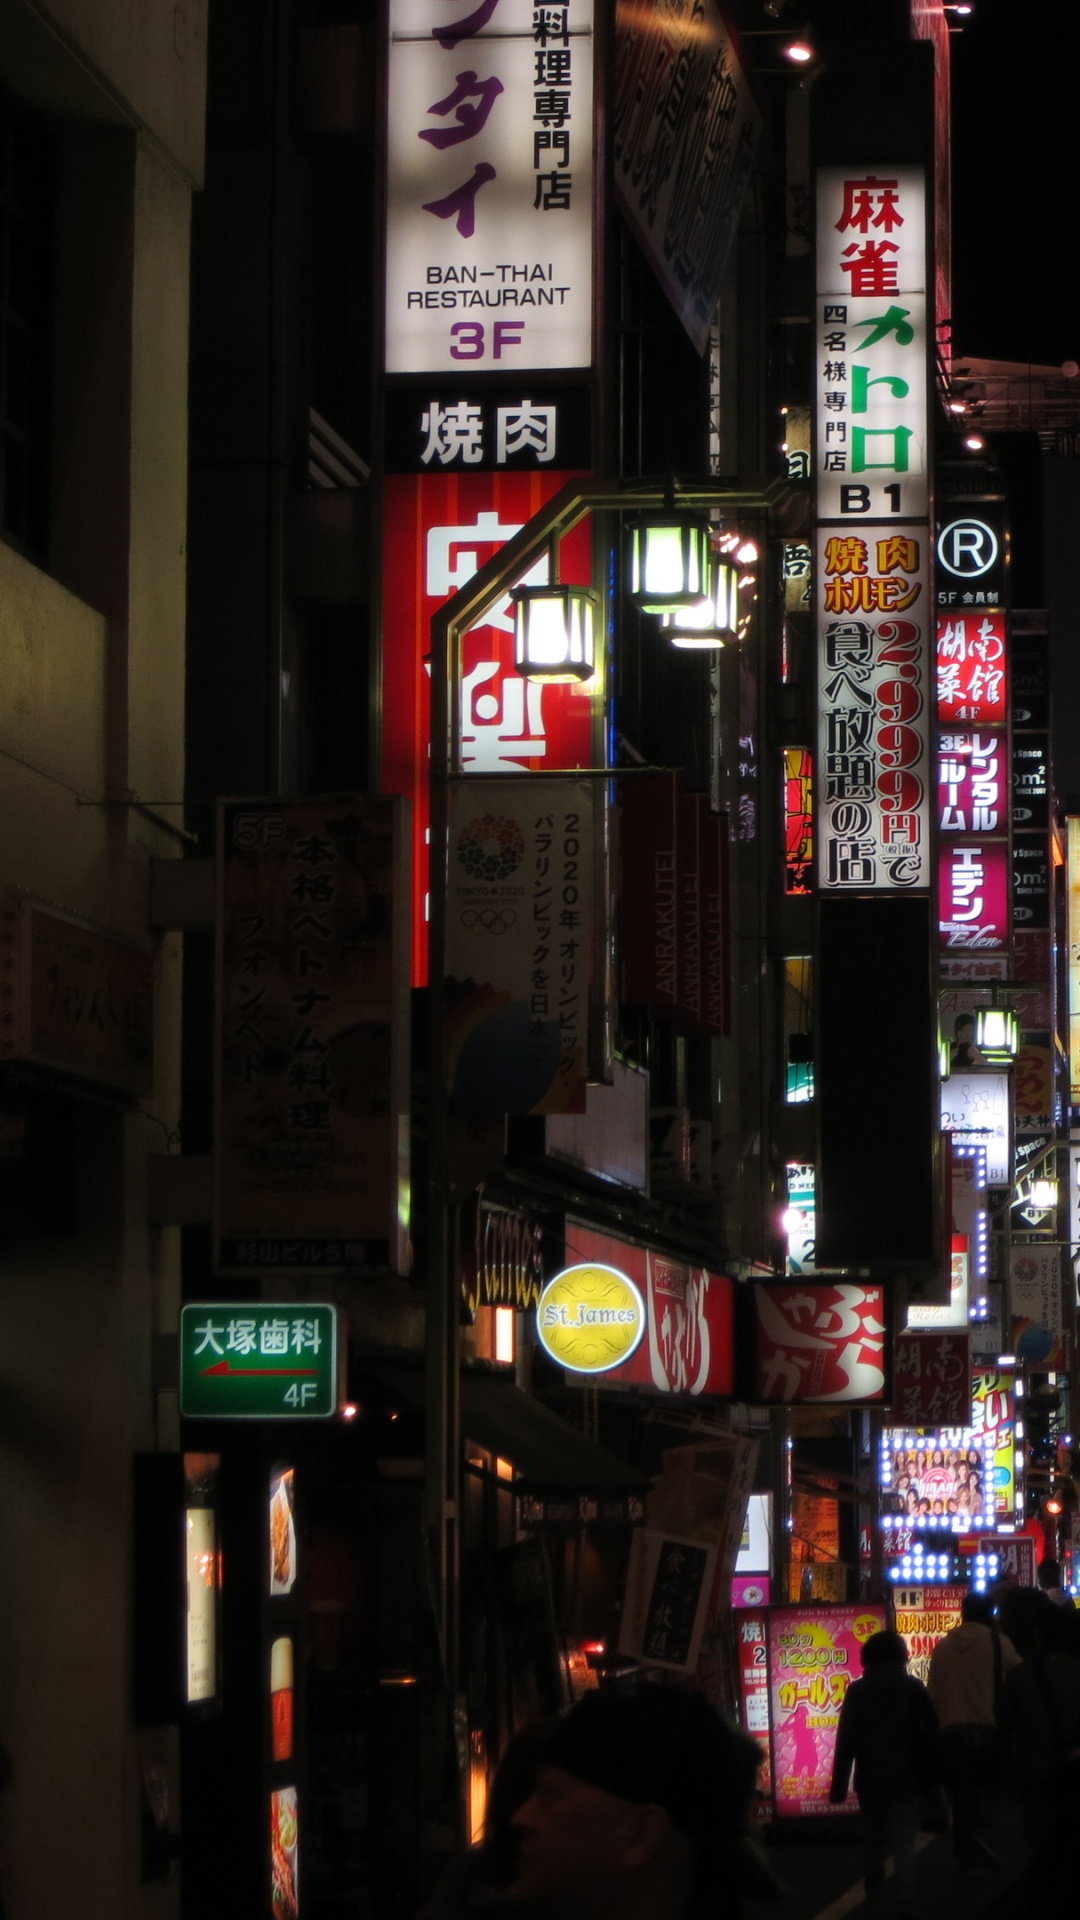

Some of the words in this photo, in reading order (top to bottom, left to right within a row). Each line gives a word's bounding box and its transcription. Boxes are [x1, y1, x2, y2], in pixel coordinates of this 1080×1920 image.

[532, 0, 572, 211] 料理専門店
[835, 176, 905, 298] 麻雀
[407, 287, 571, 309] RESTAURANT
[449, 320, 526, 360] 3F
[823, 304, 848, 473] 四名様専門店
[420, 400, 558, 466] 焼肉
[840, 484, 902, 514] B1
[824, 535, 922, 577] 焼肉
[824, 576, 922, 615] ホルモン
[938, 592, 957, 604] 5F
[954, 704, 981, 720] 4F
[823, 619, 877, 887] 食べ放題の店
[939, 735, 966, 752] 3F
[940, 758, 968, 831] ルーム
[971, 733, 998, 832] レンタル
[233, 815, 287, 849] 5F
[560, 813, 580, 931] 2020年
[951, 848, 984, 922] エデン
[655, 851, 675, 995] ANRAKUTEI
[683, 873, 699, 1013] ANRAKUTEI
[287, 834, 336, 1131] 本格ベトナム料理
[705, 893, 722, 1029] ANRAKUTEI
[193, 1318, 322, 1356] 大塚歯科
[283, 1383, 318, 1408] 4F
[741, 1621, 766, 1642] 焼
[856, 1621, 877, 1637] 3F
